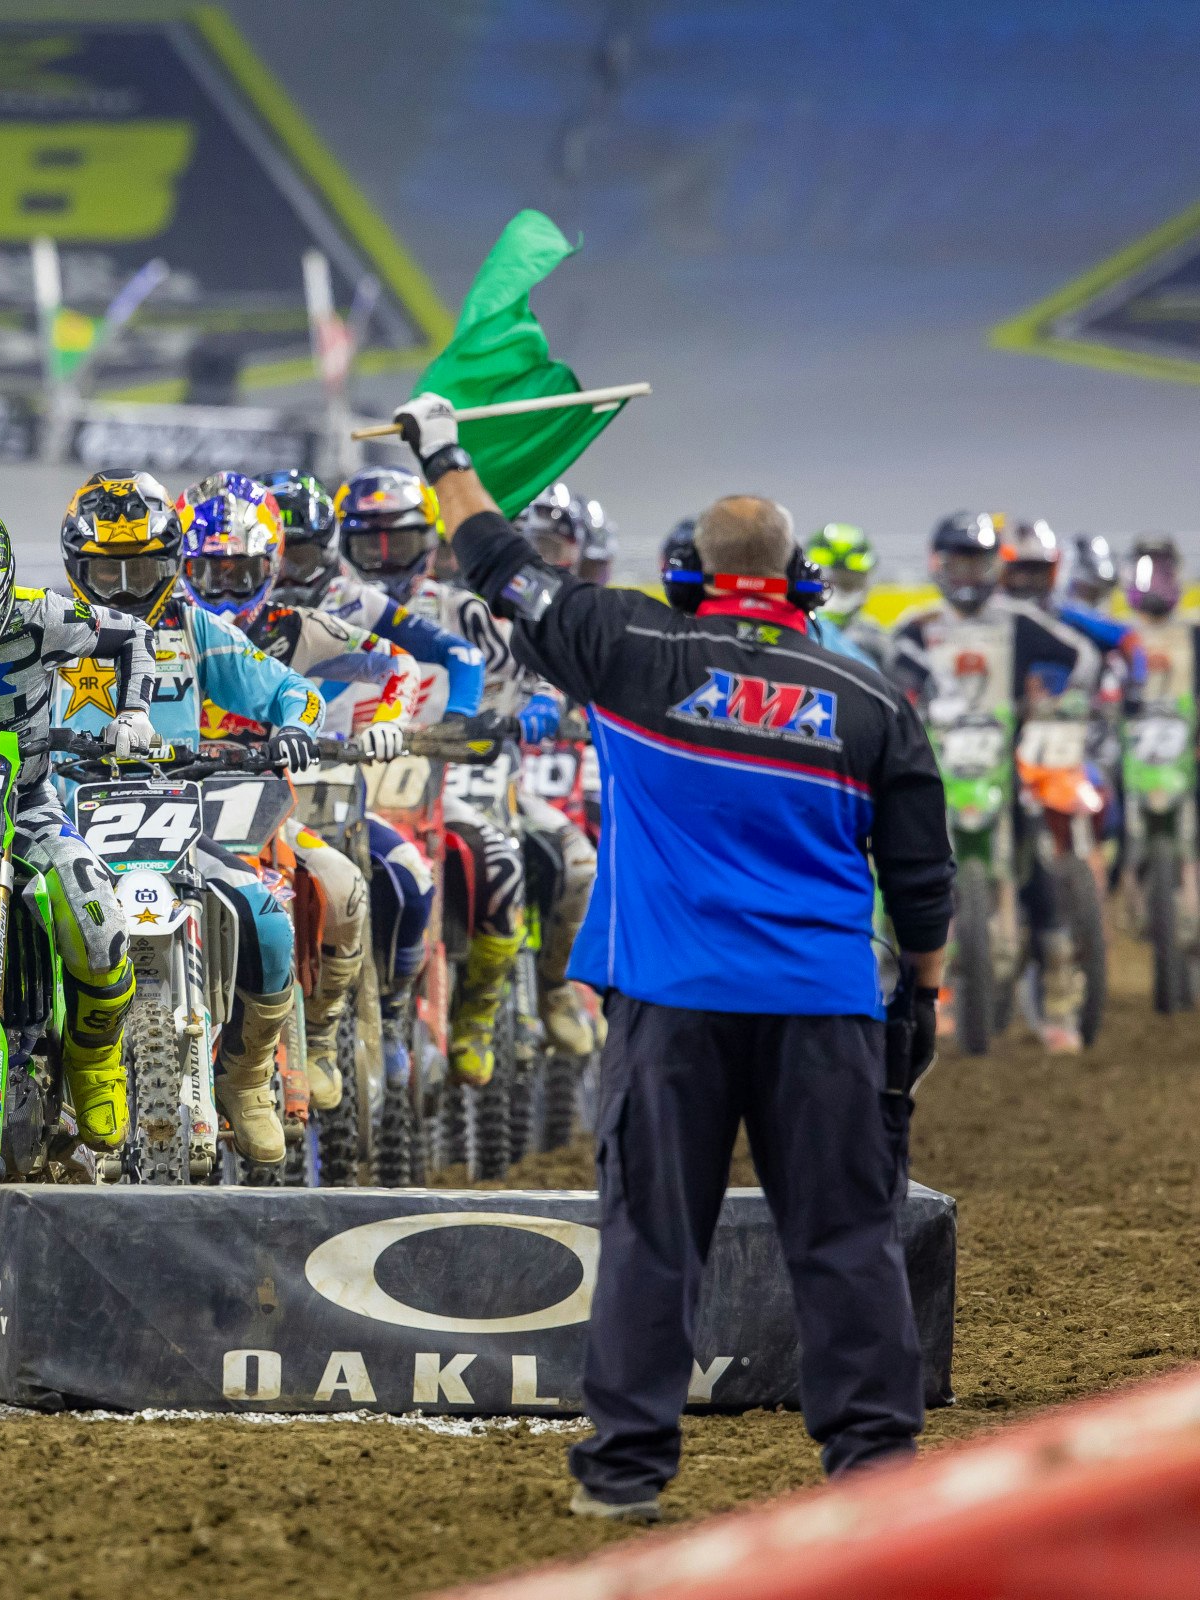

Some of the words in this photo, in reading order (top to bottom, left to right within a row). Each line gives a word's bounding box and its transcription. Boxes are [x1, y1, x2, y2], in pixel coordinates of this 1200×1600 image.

[151, 677, 194, 702] LY
[669, 666, 843, 743] AMA
[110, 789, 164, 797] SUPERCROSS
[205, 782, 265, 840] 1
[84, 802, 198, 855] 24
[126, 860, 169, 871] MOTOREX
[223, 1349, 735, 1406] OAKLY
